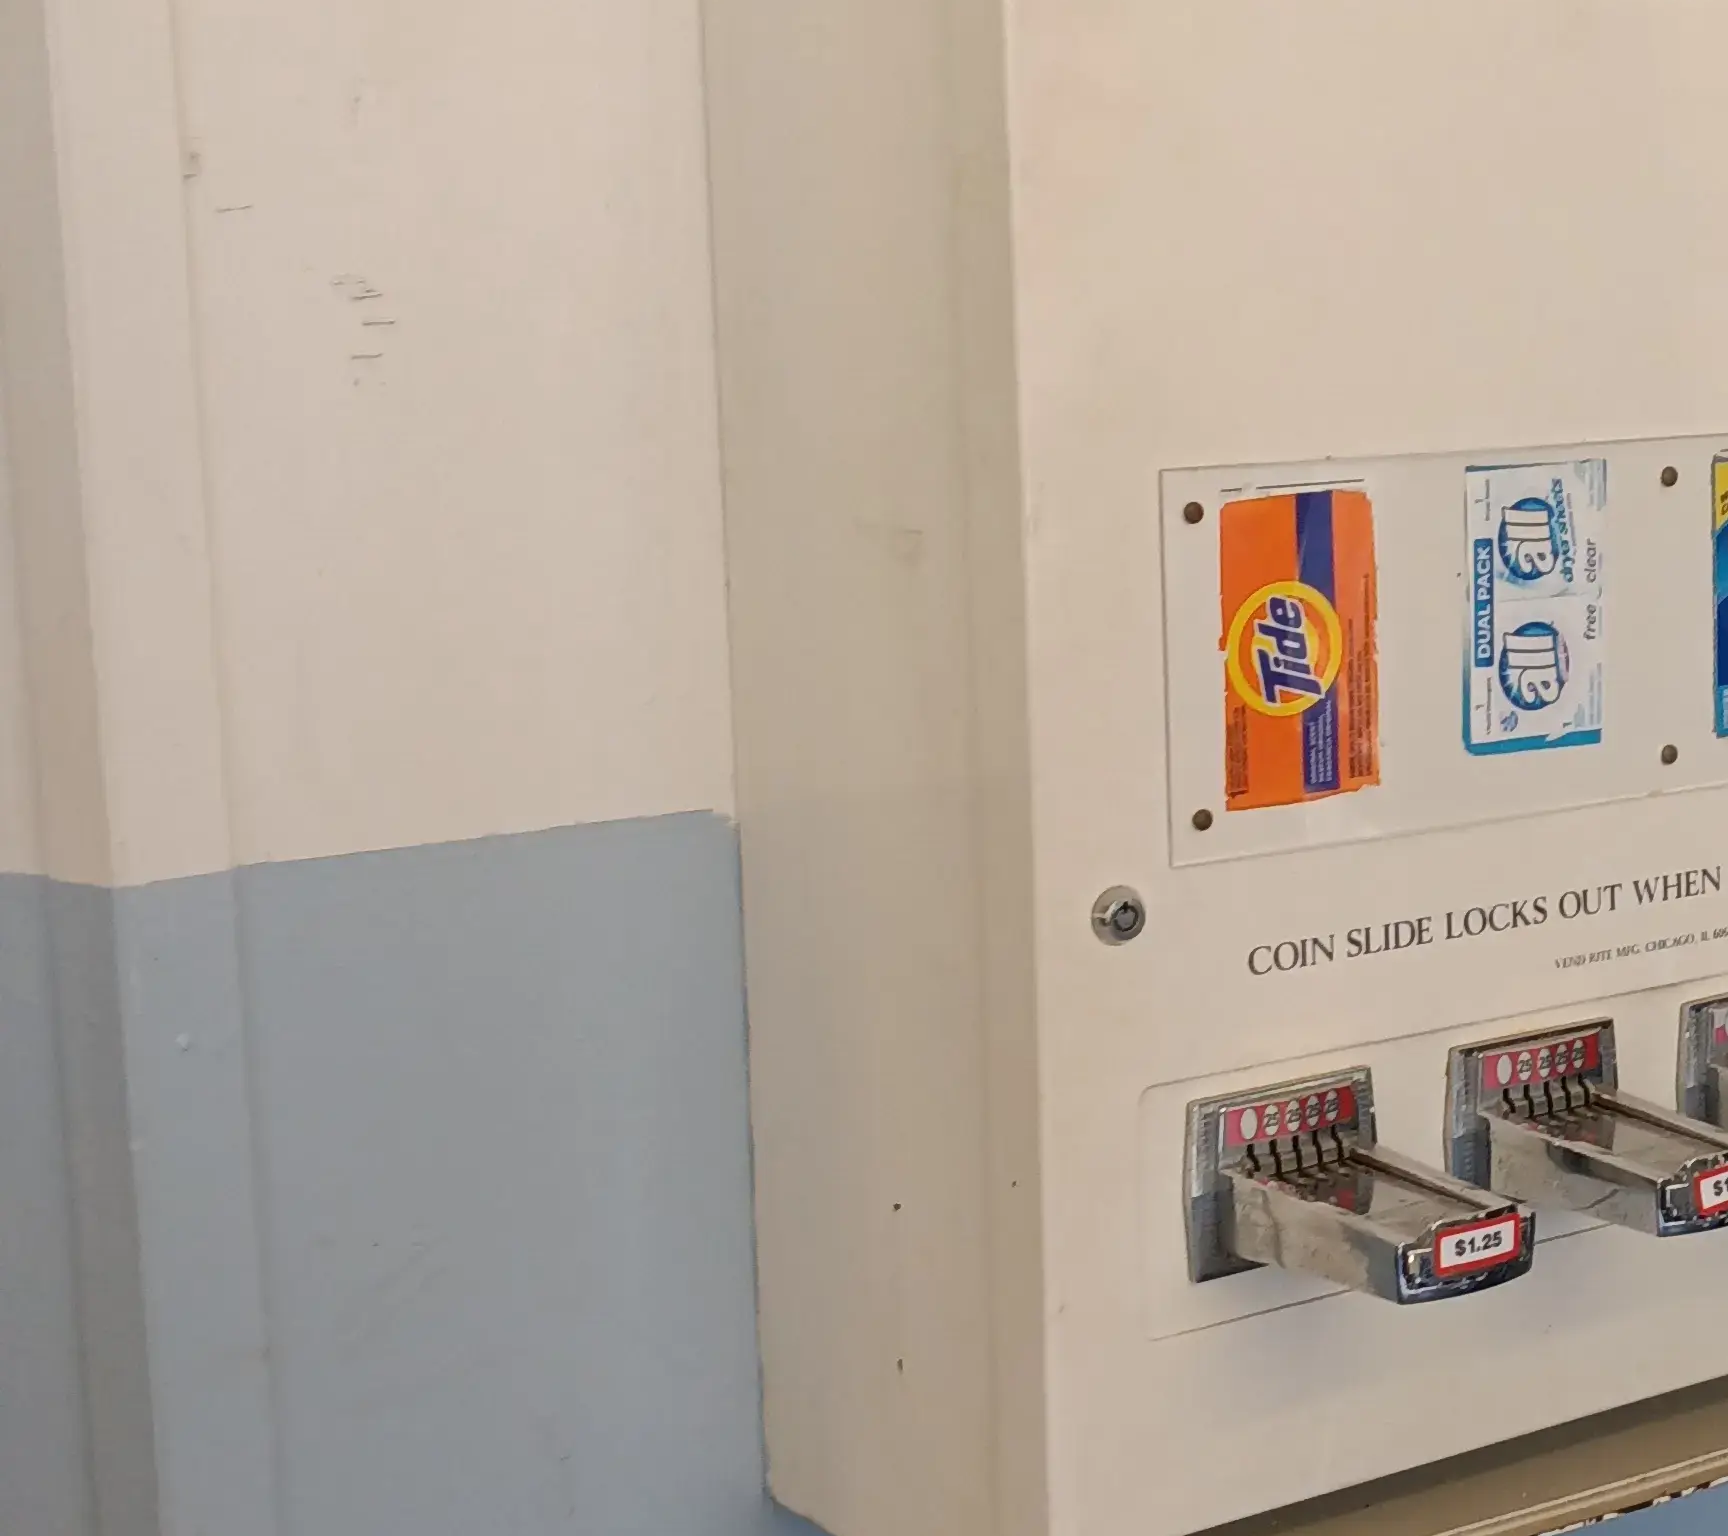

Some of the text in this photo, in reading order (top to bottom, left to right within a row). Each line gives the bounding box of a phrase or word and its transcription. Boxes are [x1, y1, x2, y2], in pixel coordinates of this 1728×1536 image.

[1476, 545, 1491, 599] PACK
[1502, 506, 1558, 575] all
[1583, 538, 1597, 641] free clear
[1256, 595, 1326, 707] Tide
[1476, 602, 1491, 660] DUAL
[1503, 632, 1560, 704] all
[1248, 934, 1335, 976] COIN
[1346, 916, 1433, 958] SLIDE
[1445, 896, 1548, 940] LOCKS
[1558, 883, 1622, 919] OUT
[1633, 865, 1721, 906] WHEN
[1454, 1229, 1503, 1257] $1.25
